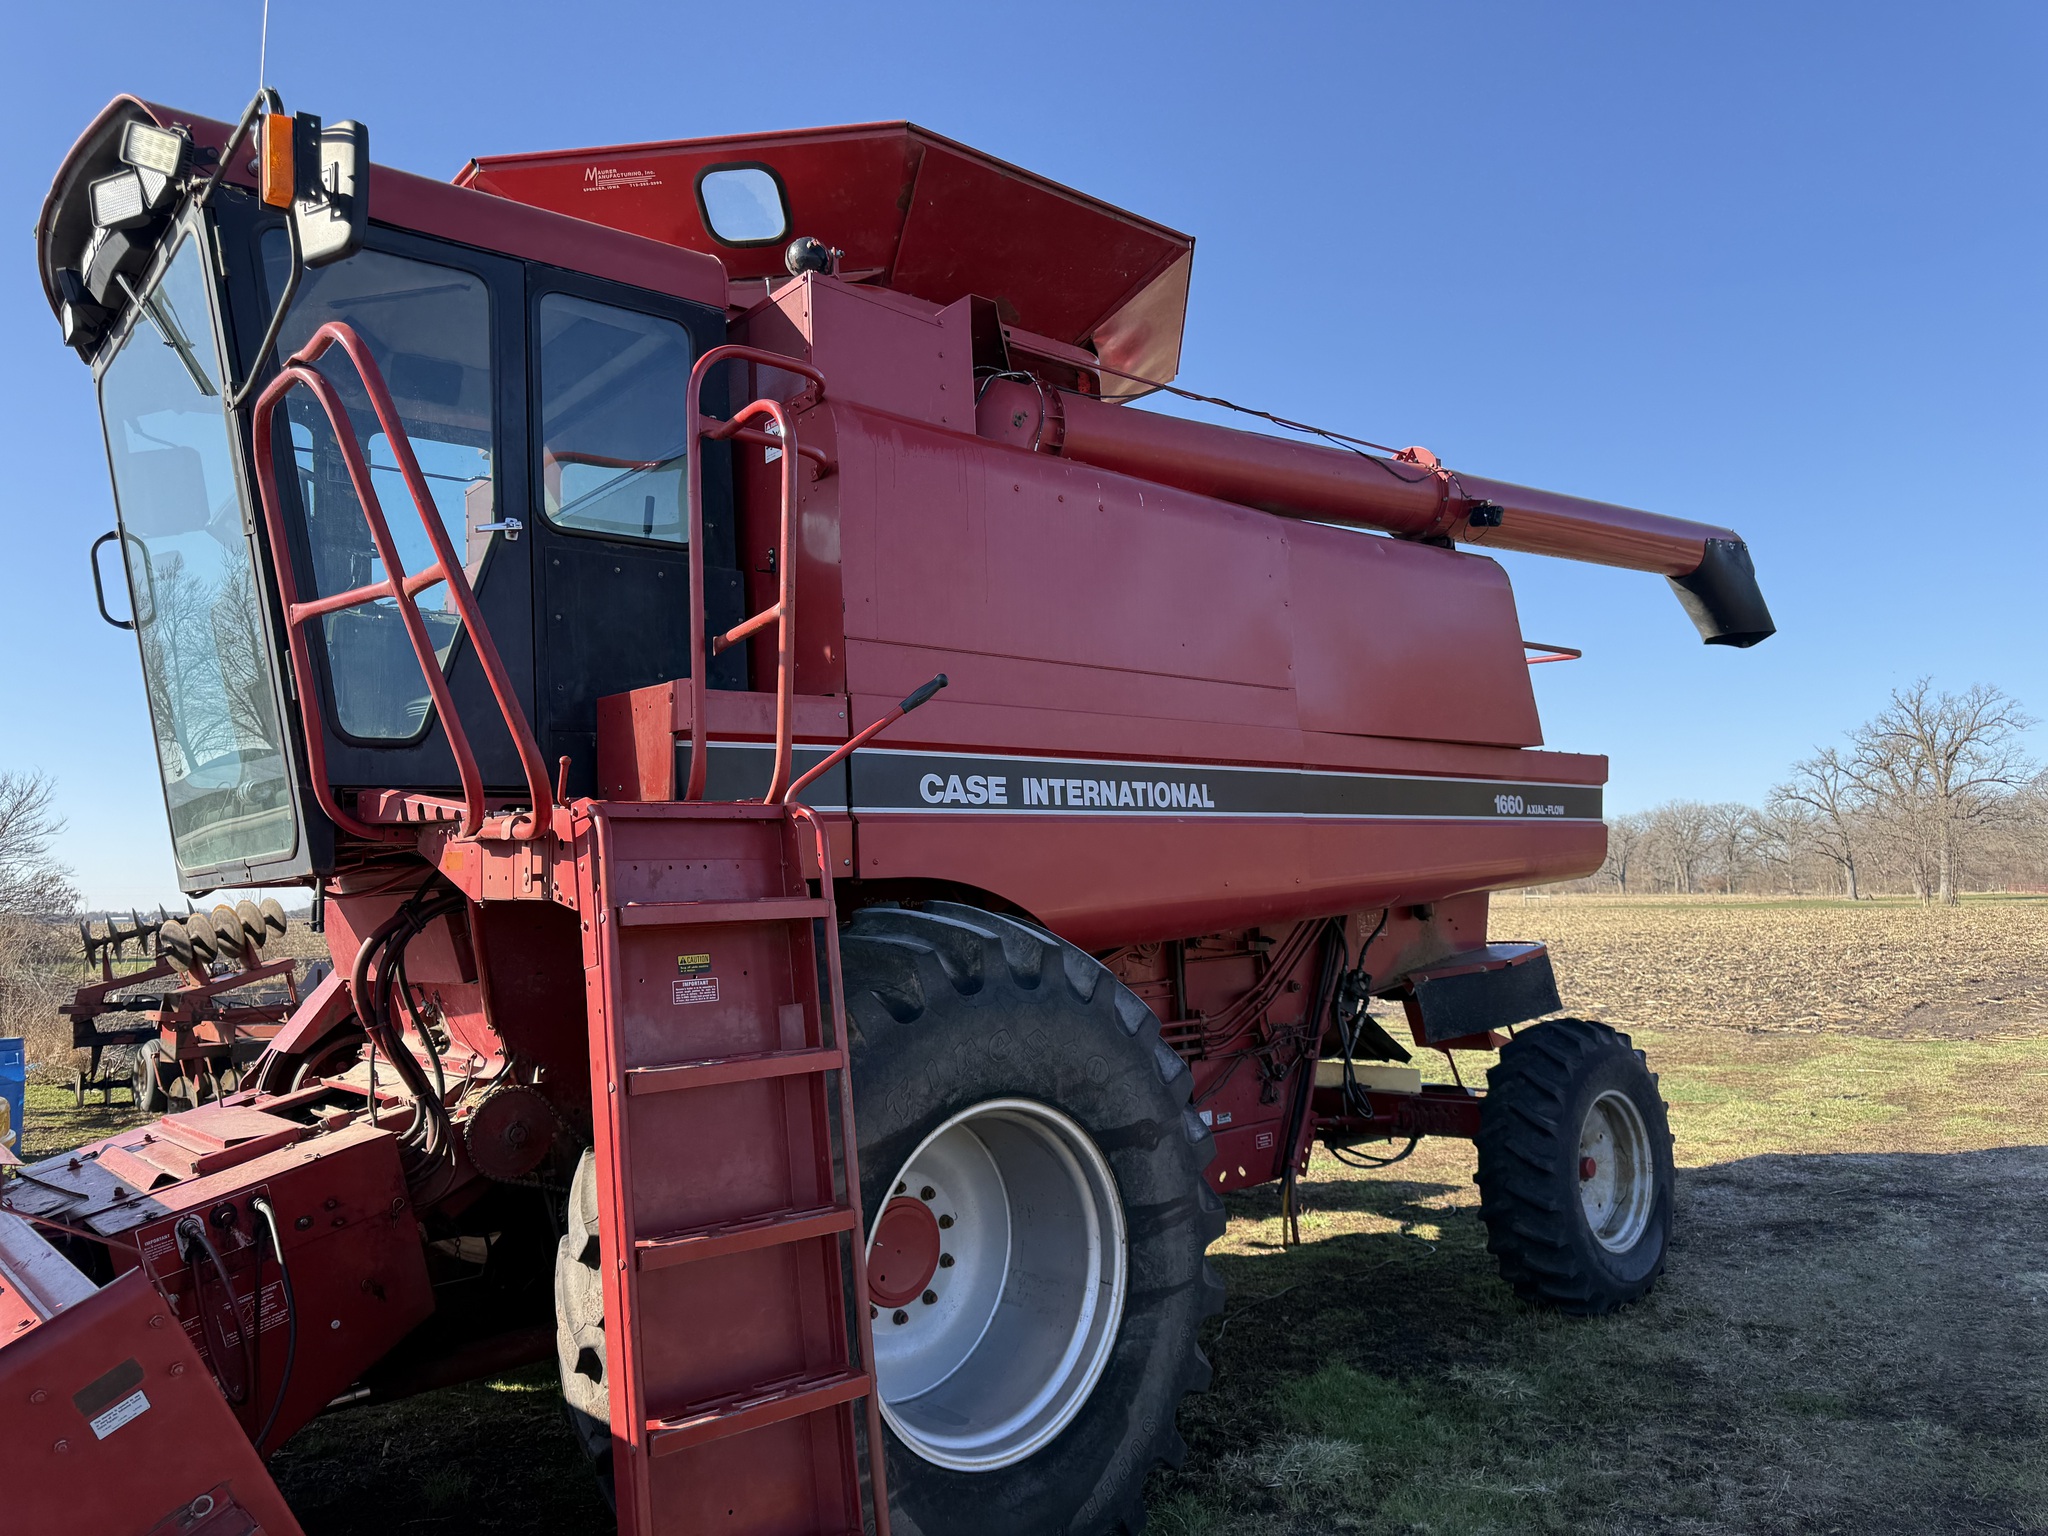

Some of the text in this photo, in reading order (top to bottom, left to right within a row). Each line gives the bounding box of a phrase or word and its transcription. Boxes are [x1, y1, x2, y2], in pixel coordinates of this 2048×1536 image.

[919, 773, 1215, 808] CASE INTERNATIONAL
[1494, 794, 1524, 815] 1660
[686, 955, 709, 964] CAUTION
[144, 1233, 170, 1247] IMPORTANT
